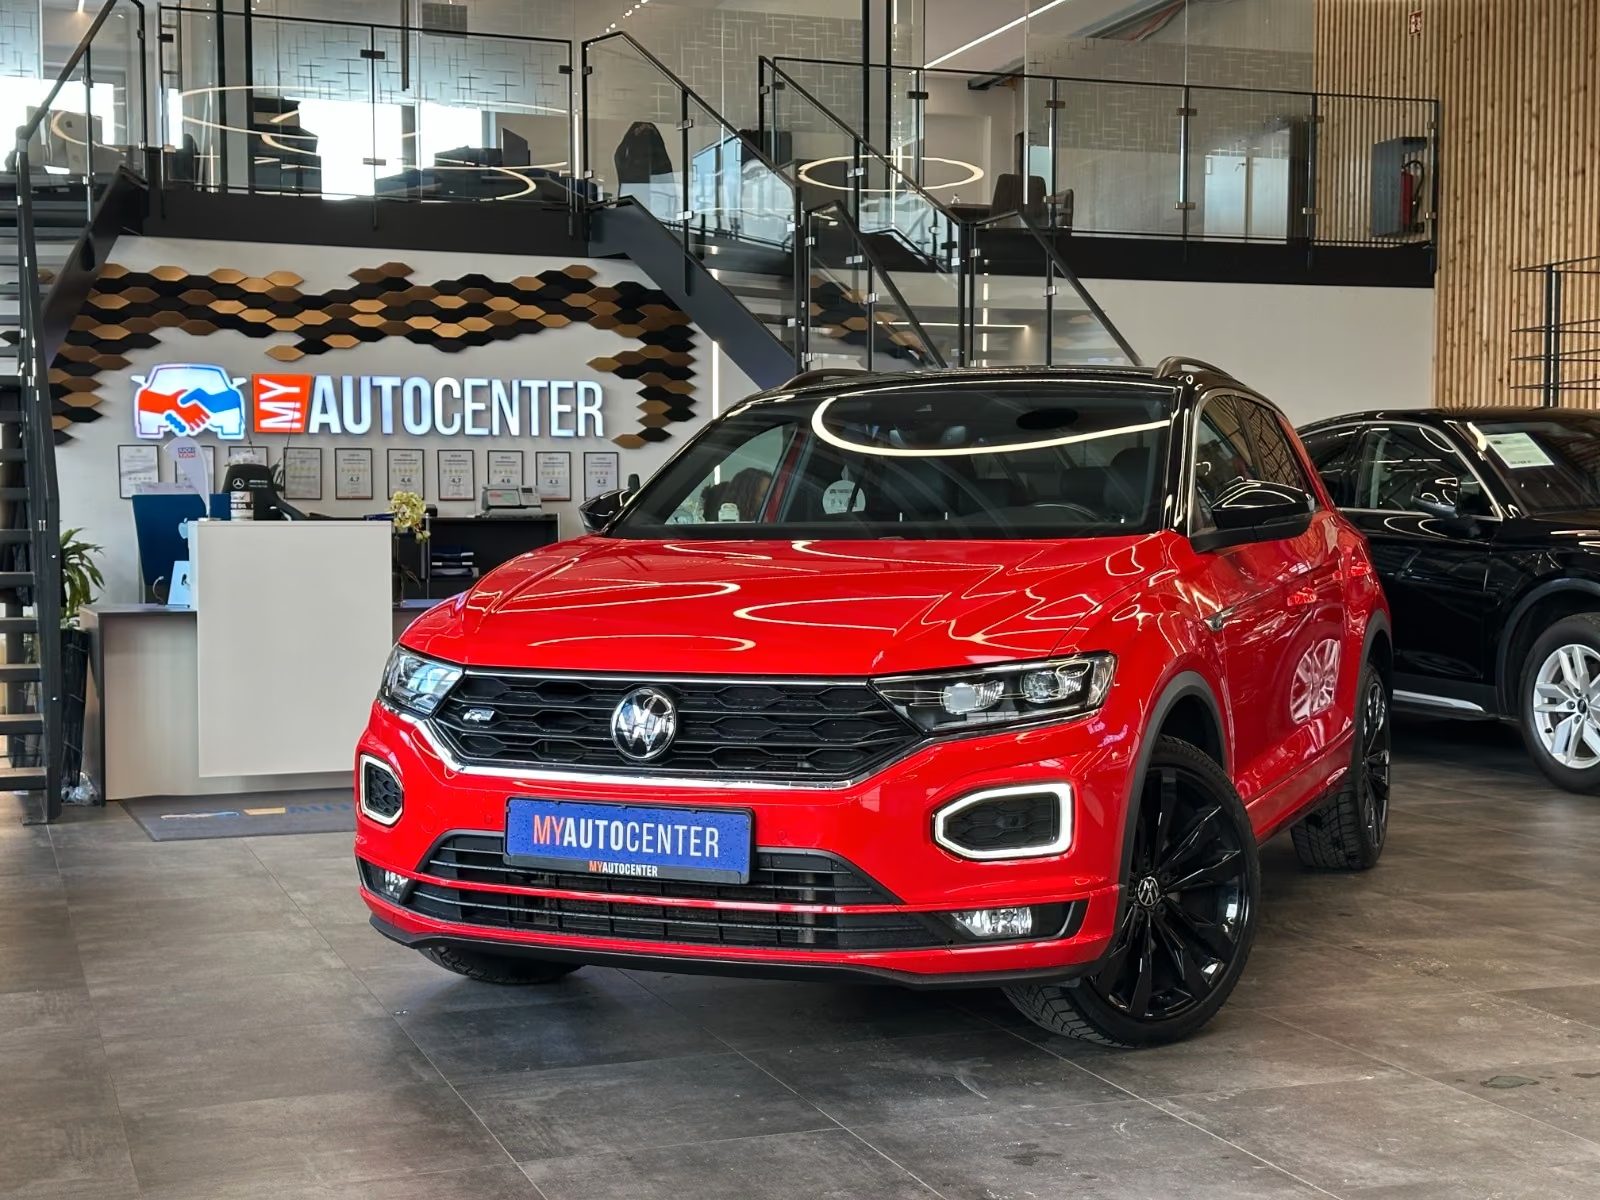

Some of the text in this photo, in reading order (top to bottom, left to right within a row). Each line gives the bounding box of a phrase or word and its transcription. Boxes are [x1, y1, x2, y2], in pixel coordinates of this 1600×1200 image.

[258, 375, 605, 437] MY AUTOCENTER
[533, 815, 720, 858] MYAUTOCENTER
[588, 860, 659, 878] MYAUTOCENTER
